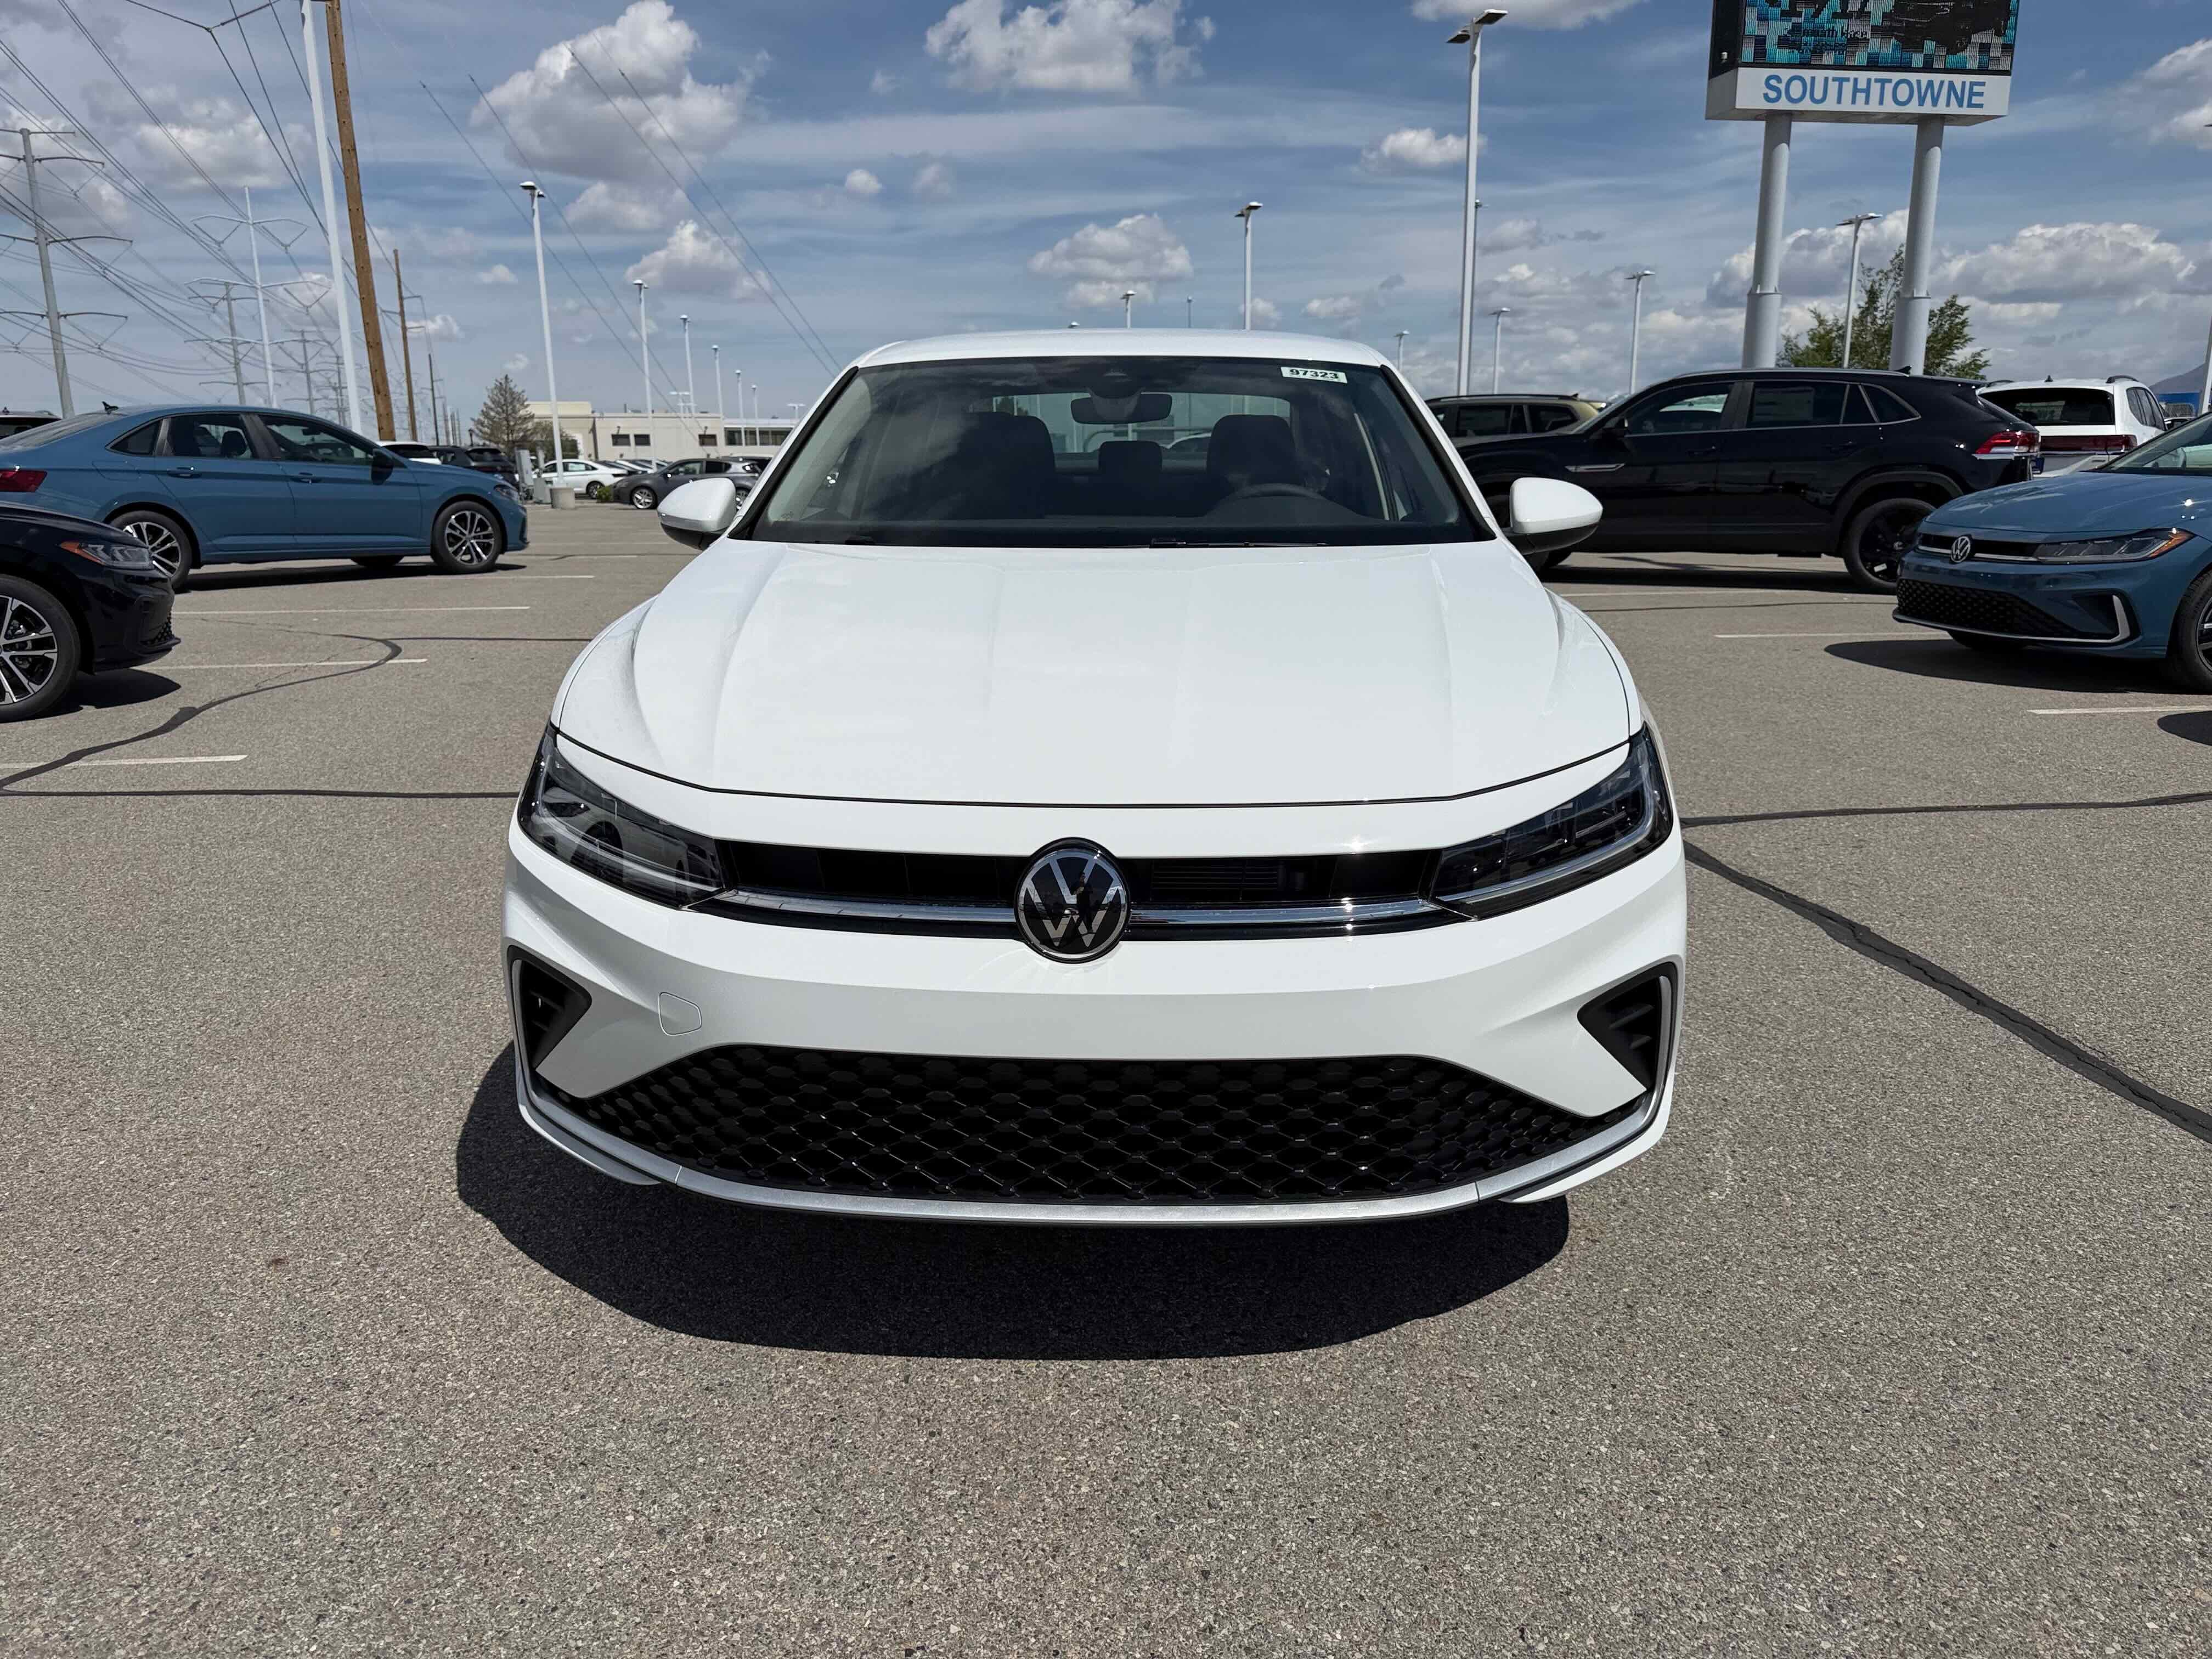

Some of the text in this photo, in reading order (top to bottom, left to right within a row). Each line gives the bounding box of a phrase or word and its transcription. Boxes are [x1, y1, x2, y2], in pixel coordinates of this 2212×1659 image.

[1763, 75, 1985, 108] SOUTHTOWNE
[1290, 369, 1339, 379] 97323
[1951, 537, 1970, 561] VW
[1022, 850, 1122, 952] VW
